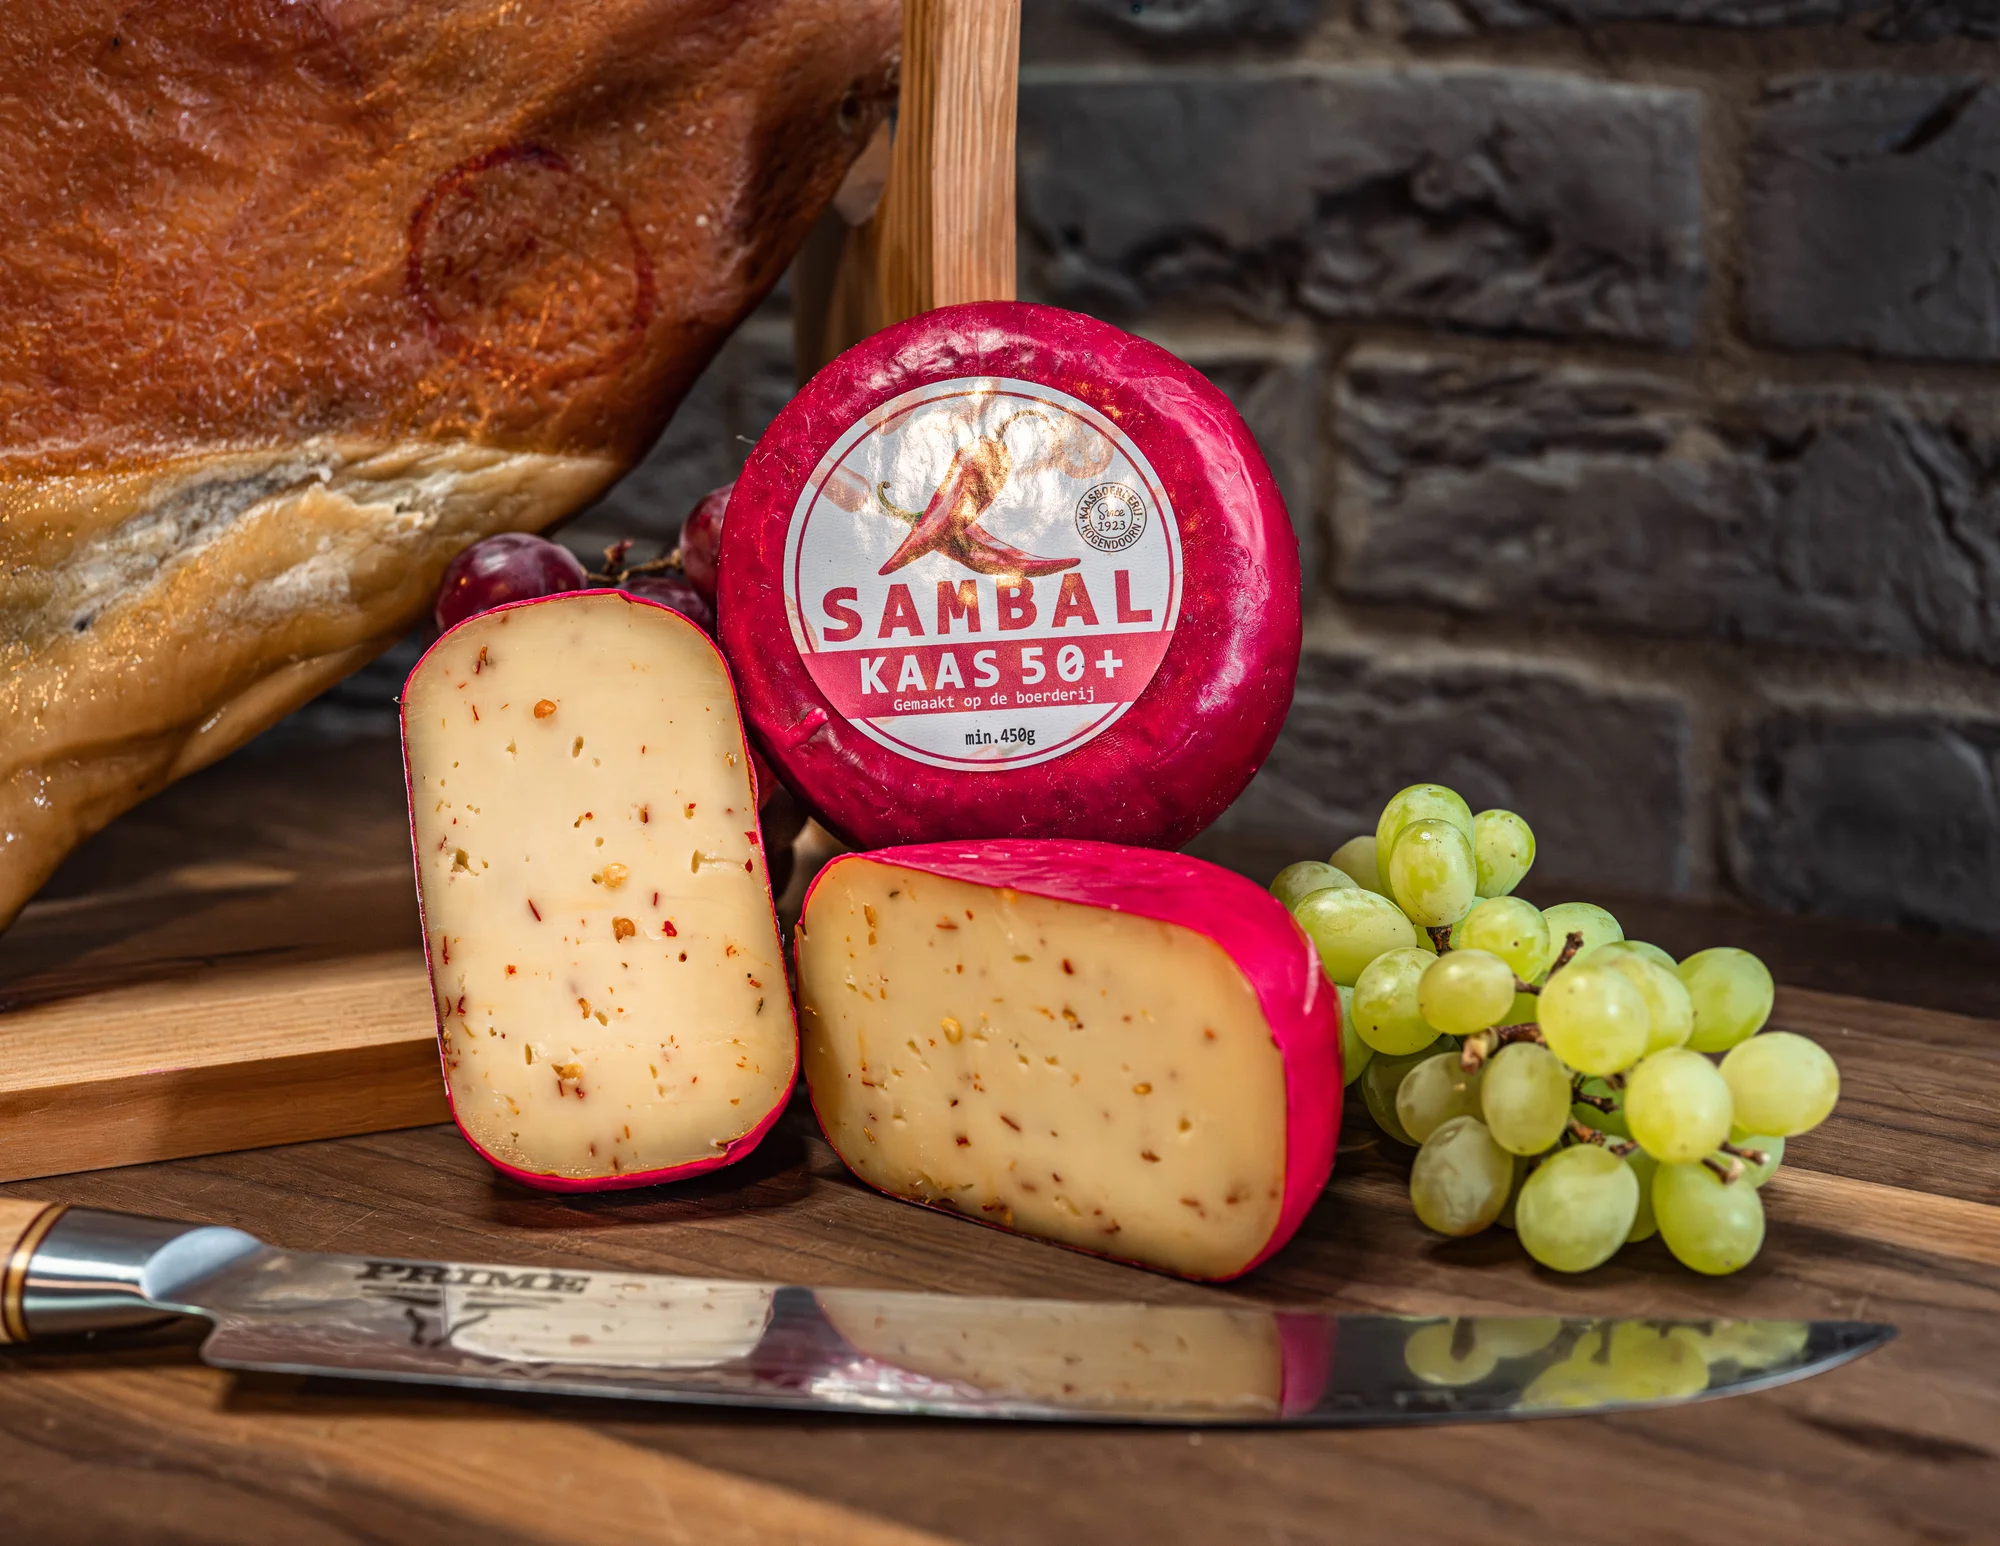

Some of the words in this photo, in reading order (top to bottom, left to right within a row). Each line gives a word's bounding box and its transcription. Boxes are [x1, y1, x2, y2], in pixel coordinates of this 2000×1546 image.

[1081, 523, 1142, 550] HOGENDOORN
[1098, 520, 1126, 532] 1923
[822, 569, 1153, 642] SAMBAL
[860, 649, 1000, 694] KAAS
[1021, 644, 1123, 684] 50+
[894, 696, 955, 711] Gemaakt
[964, 695, 981, 709] op
[990, 693, 1007, 705] de
[1017, 687, 1095, 704] boerderij
[965, 727, 1036, 746] min.450g
[354, 1260, 592, 1294] PRIME
